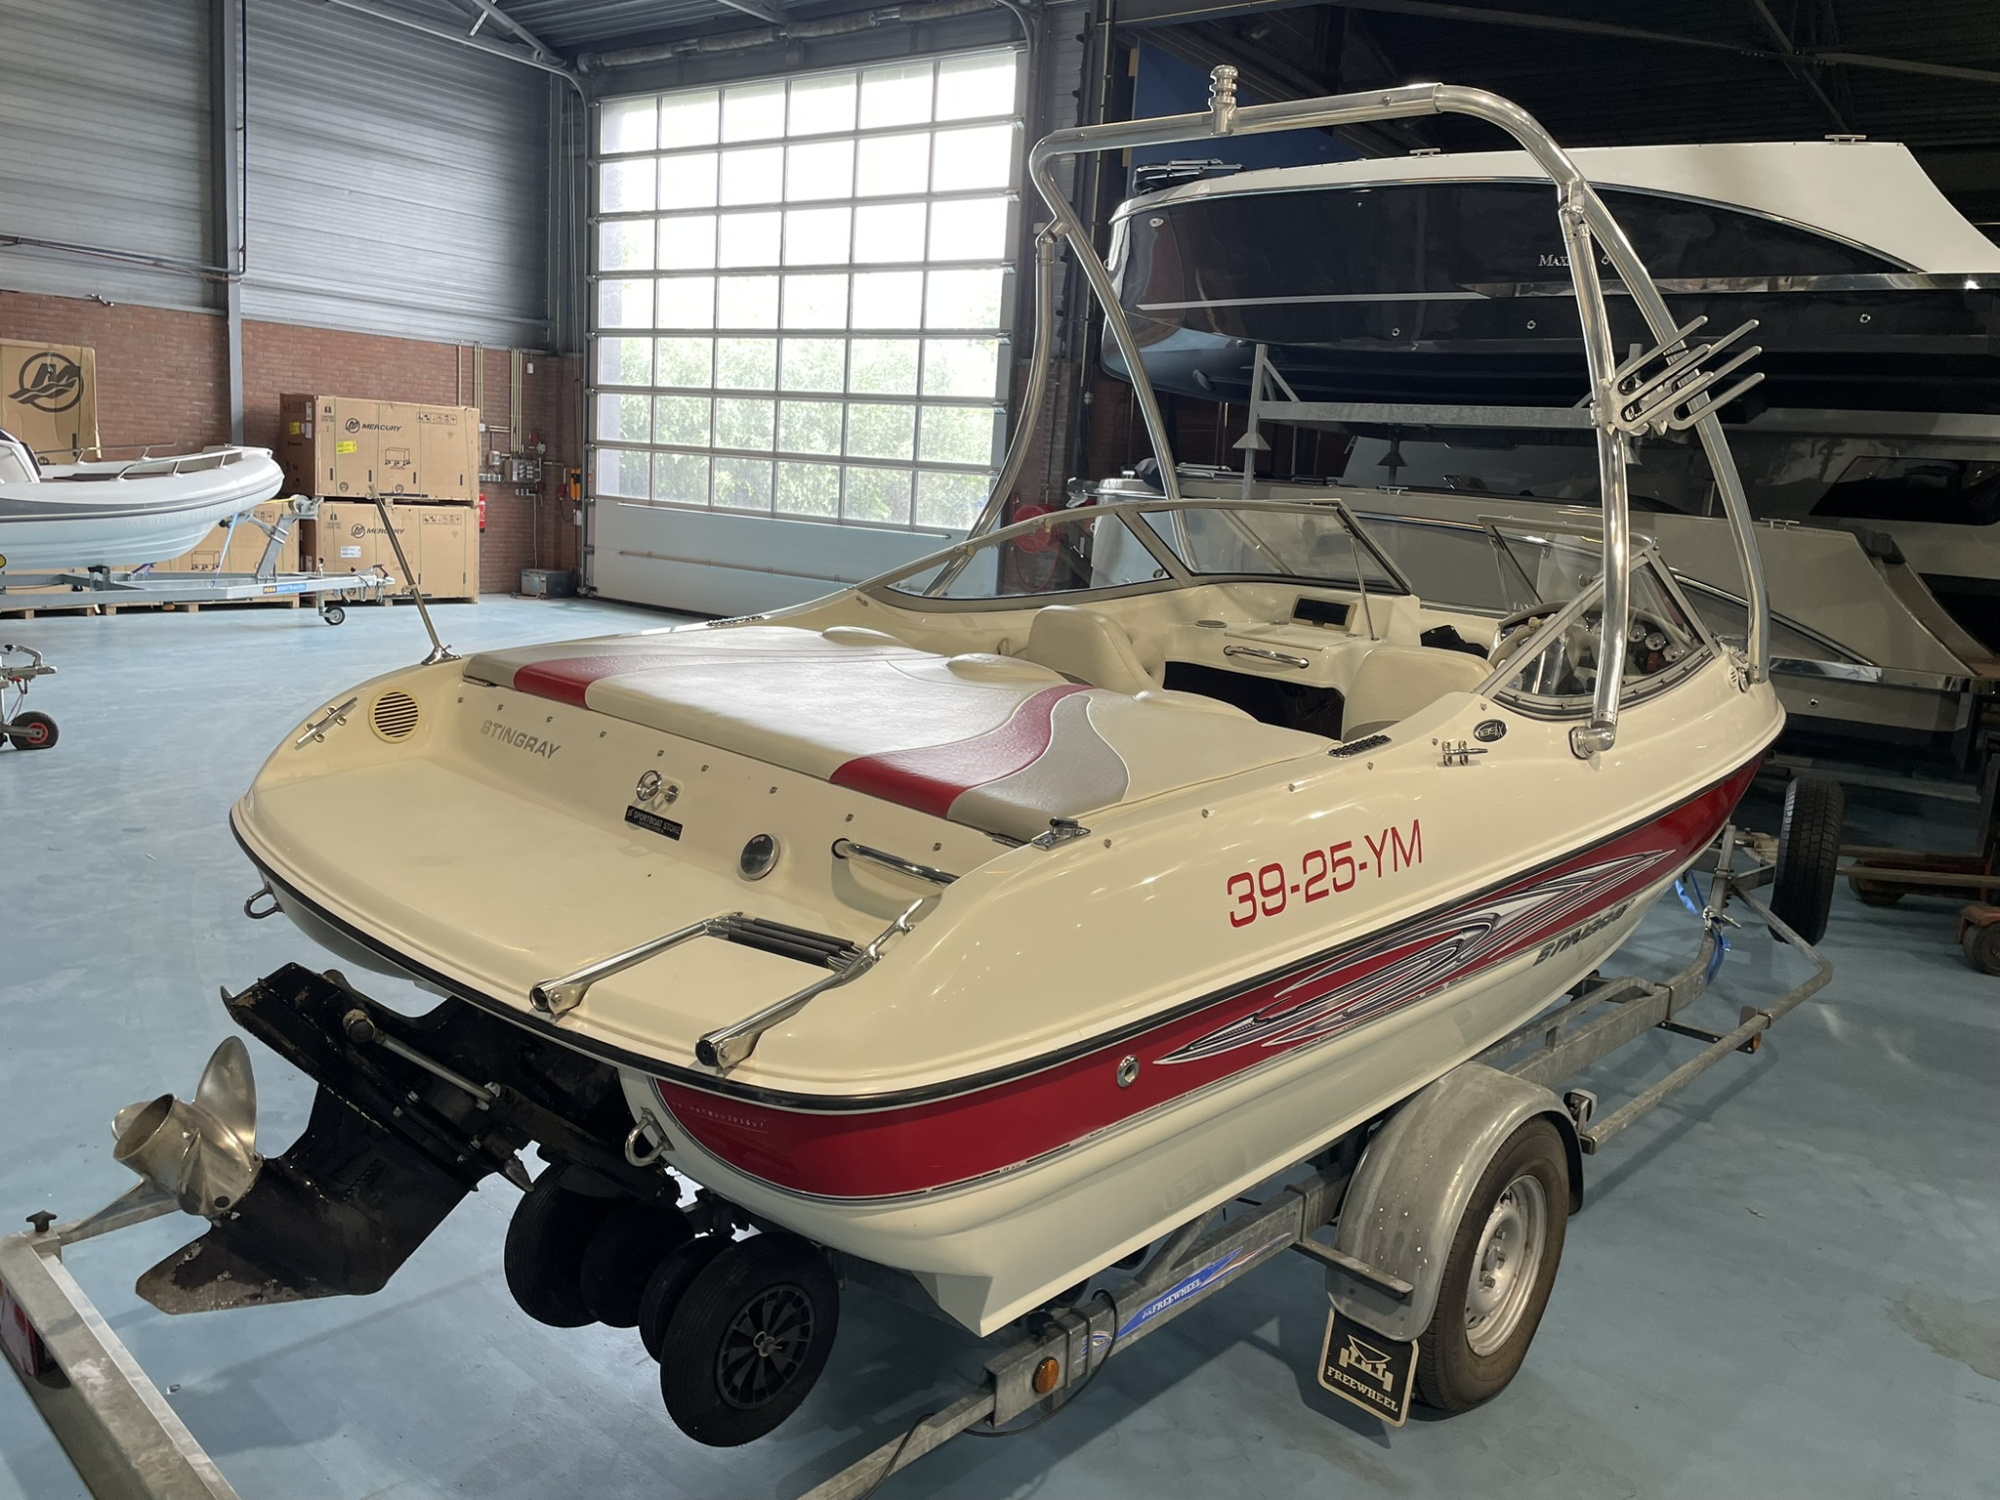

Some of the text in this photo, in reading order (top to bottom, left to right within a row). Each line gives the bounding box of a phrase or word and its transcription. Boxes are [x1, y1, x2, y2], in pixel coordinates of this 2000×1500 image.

[361, 423, 402, 432] MERCURY
[480, 720, 561, 759] STINGRAY
[633, 810, 663, 828] SPORTBOAT
[662, 821, 681, 835] STORE
[1226, 819, 1423, 928] 39-25-YM
[1152, 1278, 1201, 1313] FREEWHEEL
[1326, 1365, 1399, 1413] FREEWHEEL
